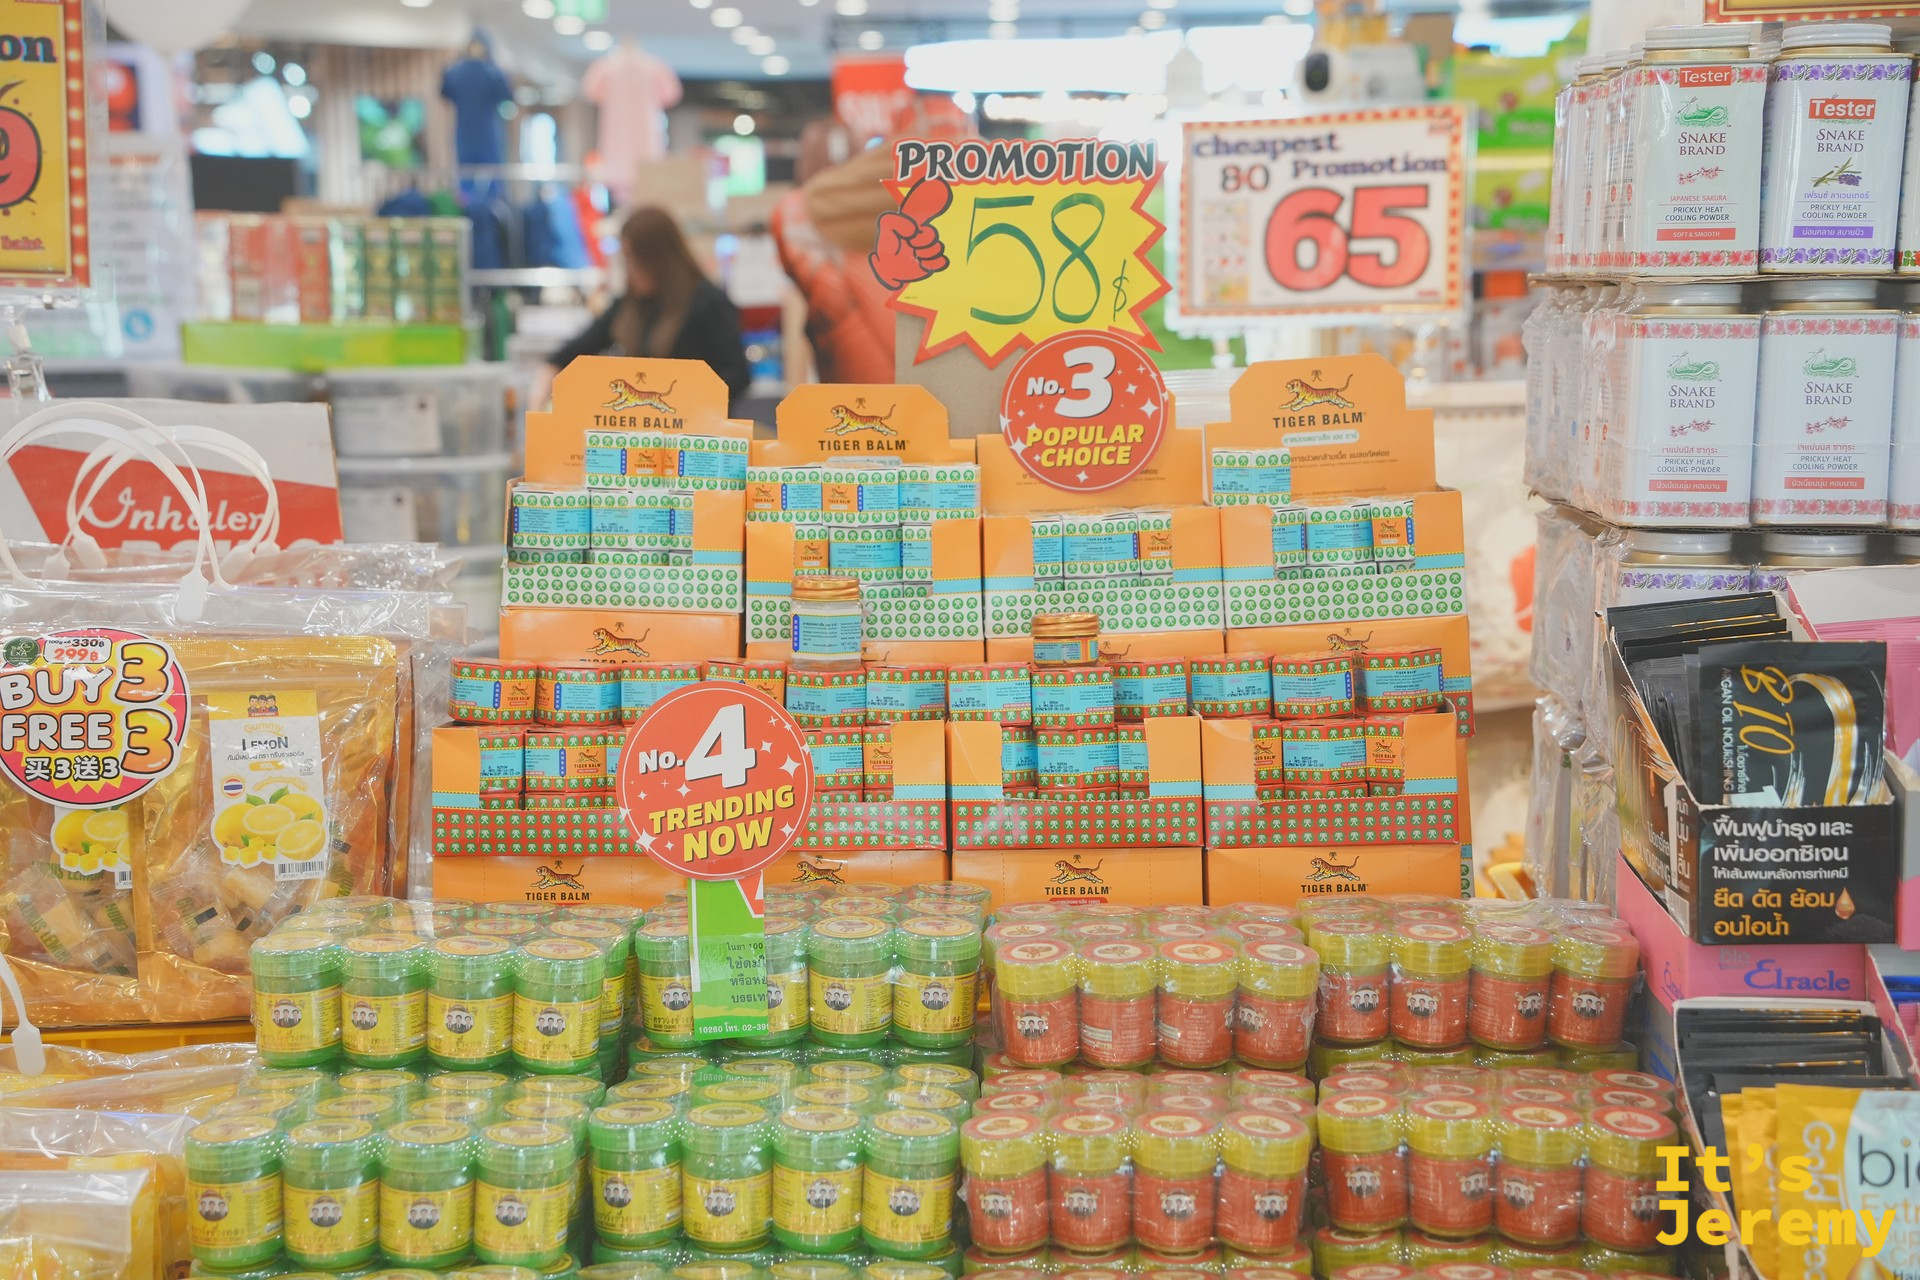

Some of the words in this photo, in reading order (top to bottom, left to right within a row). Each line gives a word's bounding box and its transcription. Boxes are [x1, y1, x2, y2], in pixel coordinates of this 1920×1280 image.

[1681, 70, 1730, 83] Tester
[1811, 100, 1875, 117] Tester
[1194, 133, 1341, 161] cheapest
[1679, 145, 1726, 156] BRAND
[1817, 142, 1864, 153] BRAND
[898, 142, 1154, 180] PROMOTION
[1293, 152, 1448, 178] Promotion
[1220, 163, 1271, 193] 80
[1802, 211, 1834, 219] COOLING
[1810, 203, 1840, 211] PRICKLY
[1699, 213, 1730, 221] POWDER
[1263, 183, 1431, 292] 65
[1669, 398, 1715, 408] BRAND
[1805, 395, 1852, 405] BRAND
[594, 415, 637, 427] TIGER
[643, 416, 684, 429] BALM
[1273, 415, 1316, 429] TIGER
[1322, 411, 1364, 425] BALM
[818, 440, 861, 451] TIGER
[866, 440, 906, 451] BALM
[1026, 424, 1145, 448] POPULAR
[1040, 446, 1133, 468] CHOICE
[0, 667, 114, 711] BUY
[115, 642, 169, 703] 3
[1721, 667, 1733, 704] ARGAN
[1722, 707, 1733, 724] OIL
[1, 712, 113, 751] FREE
[121, 708, 174, 774] 3
[1722, 727, 1734, 792] NOURISHING
[648, 785, 795, 835] TRENDING
[1712, 814, 1817, 842] ฟื้นฟูบำรุง
[1819, 821, 1853, 837] และ
[683, 817, 775, 862] NOW
[1713, 840, 1849, 862] เพิ่มออกซิเจน
[1712, 866, 1849, 880] ให้เส้นผมหลังการทำเคมี
[525, 892, 556, 901] TIGER
[561, 892, 590, 901] BALM
[1045, 886, 1076, 896] TIGER
[1080, 886, 1109, 895] BALM
[1301, 884, 1332, 893] TIGER
[1336, 883, 1366, 892] BALM
[1713, 887, 1744, 908] ยืด
[1751, 888, 1782, 908] ดัด
[1789, 887, 1835, 908] ย้อม
[1713, 912, 1790, 936] อบไอน้ำ
[1743, 958, 1851, 992] Elracle
[698, 1026, 723, 1034] 10260
